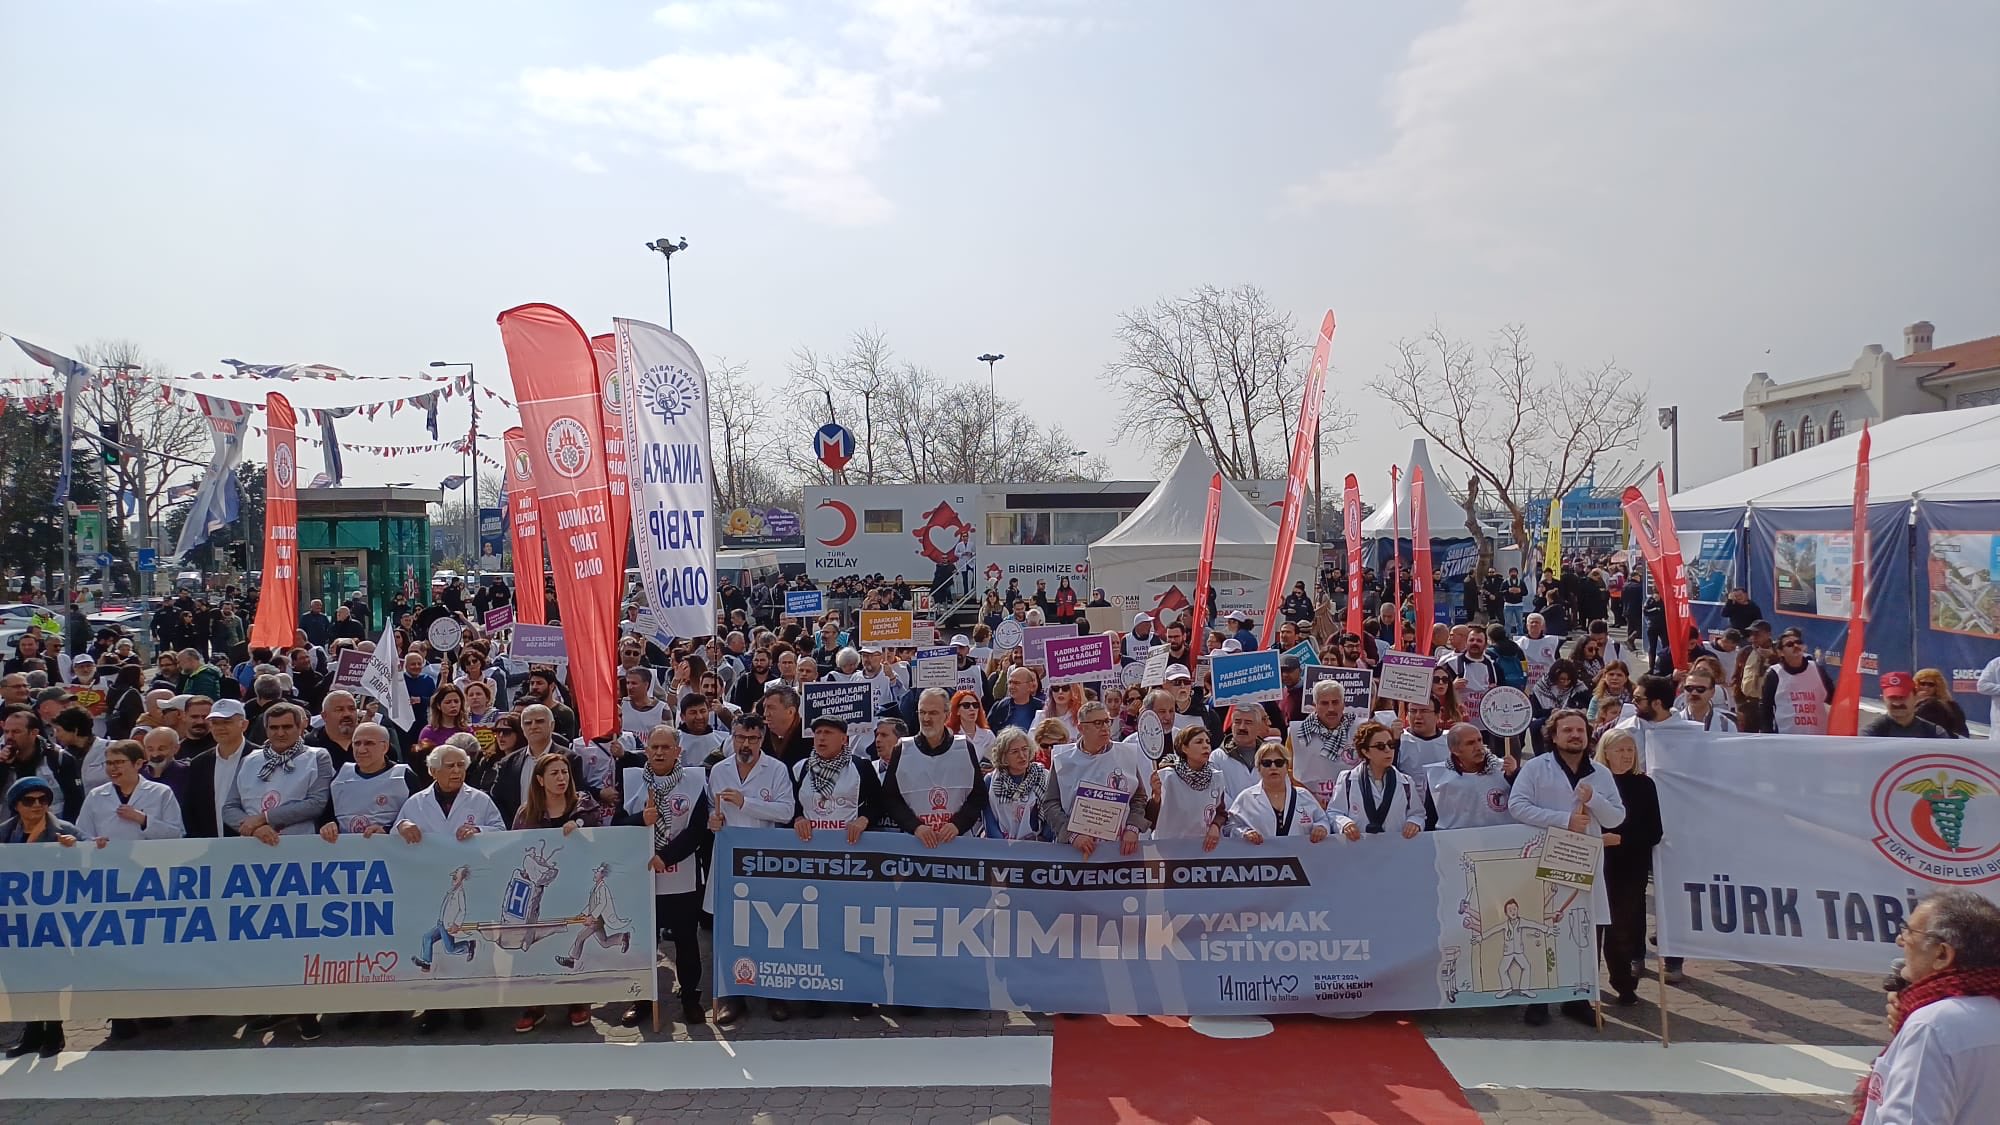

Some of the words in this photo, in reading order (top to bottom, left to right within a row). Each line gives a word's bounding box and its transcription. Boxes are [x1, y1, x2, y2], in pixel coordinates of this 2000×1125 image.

[815, 558, 858, 568] KIZILAY
[1008, 562, 1072, 574] BİRBİRİMİZE
[1054, 646, 1080, 656] KADINA
[1056, 655, 1074, 664] HALK
[1220, 668, 1249, 681] PARASIZ
[1218, 677, 1248, 689] PARASIZ
[806, 687, 847, 701] KARANLIĞA
[1883, 837, 1913, 865] TÜRK
[1918, 859, 1985, 878] TABİPLERİ
[741, 850, 874, 880] ŞİDDETSİZ,
[880, 857, 985, 882] GÜVENLİ
[992, 866, 1024, 884] VE
[1030, 862, 1166, 886] GÜVENCELİ
[1172, 864, 1298, 884] ORTAMDA
[0, 865, 211, 907] RUMLARI
[221, 860, 394, 899] AYAKTA
[1683, 873, 1803, 938] TÜRK
[0, 906, 217, 948] HAYATTA
[228, 901, 394, 941] KALSIN
[732, 882, 819, 950] İYİ
[843, 892, 1196, 961] HEKİMLİK
[1199, 910, 1331, 933] YAPMAK
[1199, 933, 1370, 962] İSTİYORUZ!
[759, 961, 824, 977] İSTANBUL
[759, 974, 796, 989] TABİP
[799, 976, 844, 991] ODASI
[1314, 981, 1345, 990] BÜYÜK
[1346, 980, 1373, 990] HEKİM
[1315, 991, 1362, 1000] YÜRÜYÜŞÜ
